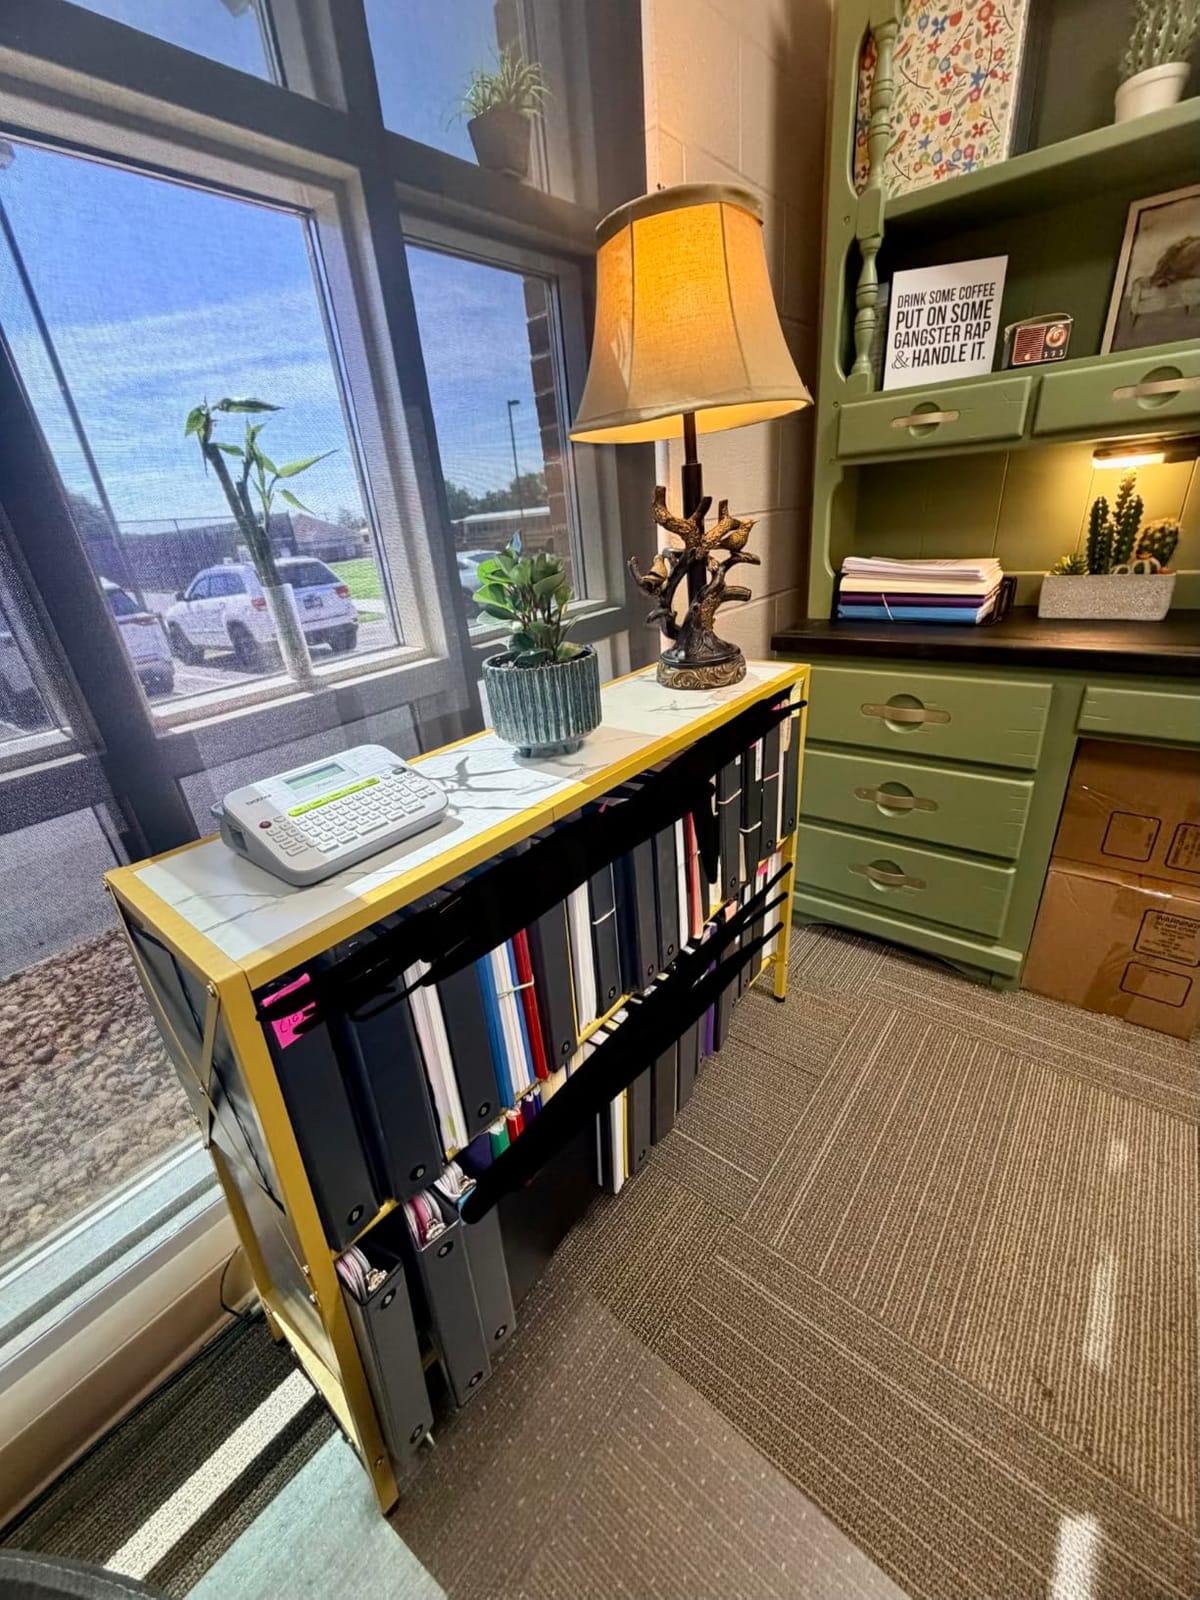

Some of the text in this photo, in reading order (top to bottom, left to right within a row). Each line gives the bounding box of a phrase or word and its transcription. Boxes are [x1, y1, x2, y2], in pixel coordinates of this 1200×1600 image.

[897, 282, 996, 308] DRINK SOME COFFEE
[896, 299, 993, 331] PUT ON SOME
[894, 321, 991, 349] GANGSTER RAP
[891, 341, 985, 369] & HANDLE IT.
